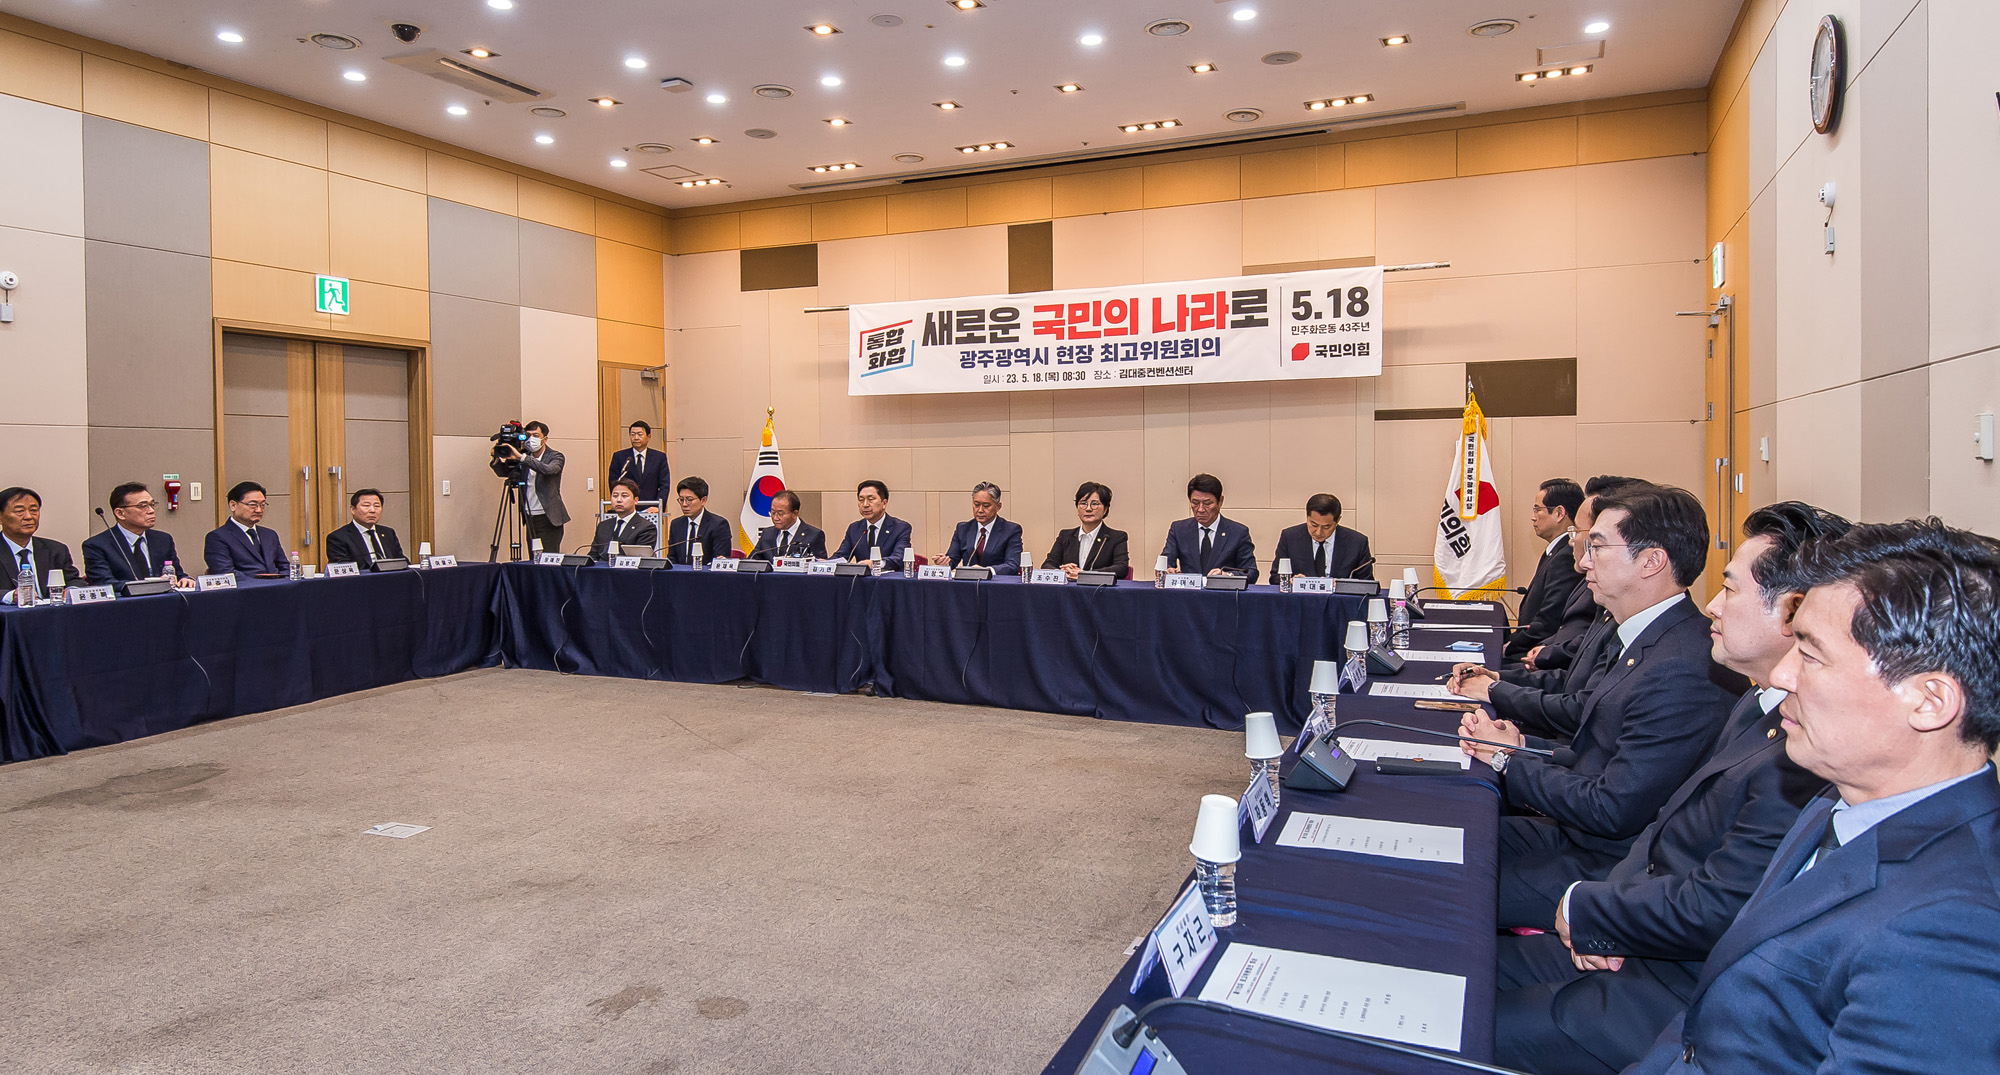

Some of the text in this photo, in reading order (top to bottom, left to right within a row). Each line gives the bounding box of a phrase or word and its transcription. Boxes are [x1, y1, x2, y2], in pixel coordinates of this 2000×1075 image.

[1291, 286, 1370, 321] 5.18
[922, 288, 1269, 347] 새로운 국민의 나라로
[1291, 321, 1370, 336] 민주화운동 43주년
[866, 327, 904, 351] 통합
[1314, 342, 1370, 358] 국민의힘
[868, 347, 906, 370] 화합
[959, 336, 1221, 369] 광주광역시 현장 최고위원회의
[983, 374, 1000, 384] 일시
[1062, 370, 1086, 382] 08:30
[1093, 369, 1112, 380] 장소
[1118, 365, 1194, 379] 김대중컨벤션센터
[1467, 436, 1475, 464] 국민의힘
[1172, 915, 1207, 971] 구자근
